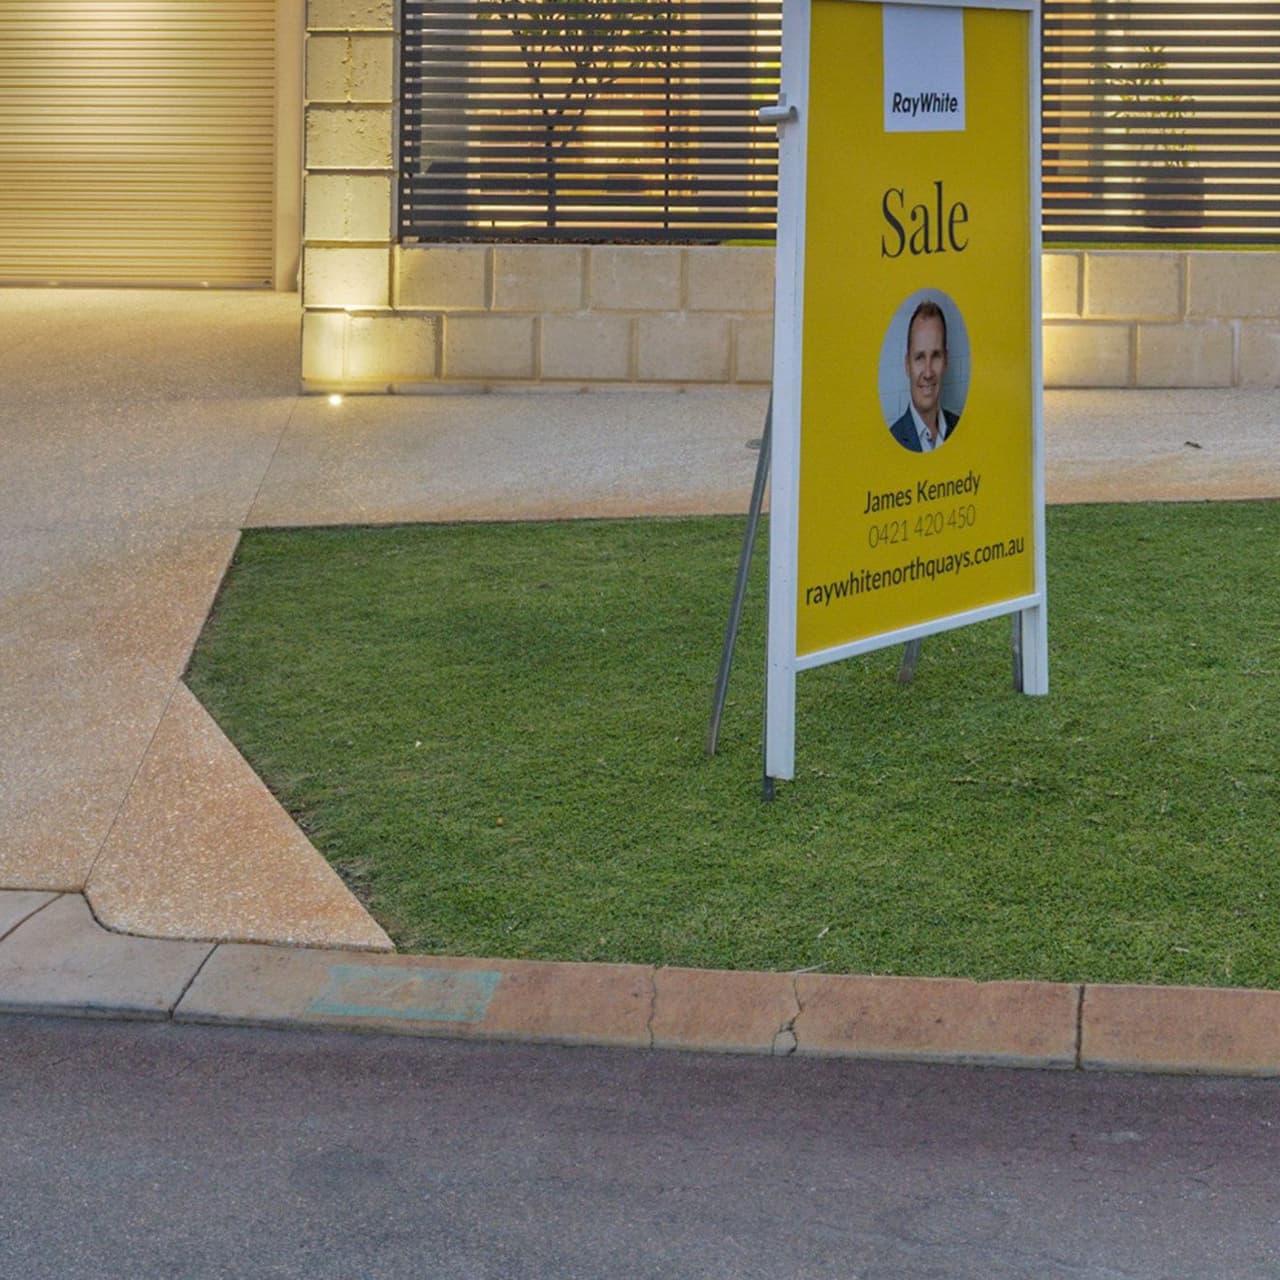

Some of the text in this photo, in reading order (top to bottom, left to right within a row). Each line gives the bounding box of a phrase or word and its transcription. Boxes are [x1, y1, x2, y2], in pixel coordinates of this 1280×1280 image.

[881, 180, 969, 258] Sale
[863, 469, 981, 515] James Kennedy
[868, 503, 976, 549] 0421 420 450
[805, 535, 1025, 607] raywhitenorthquays.com.au
